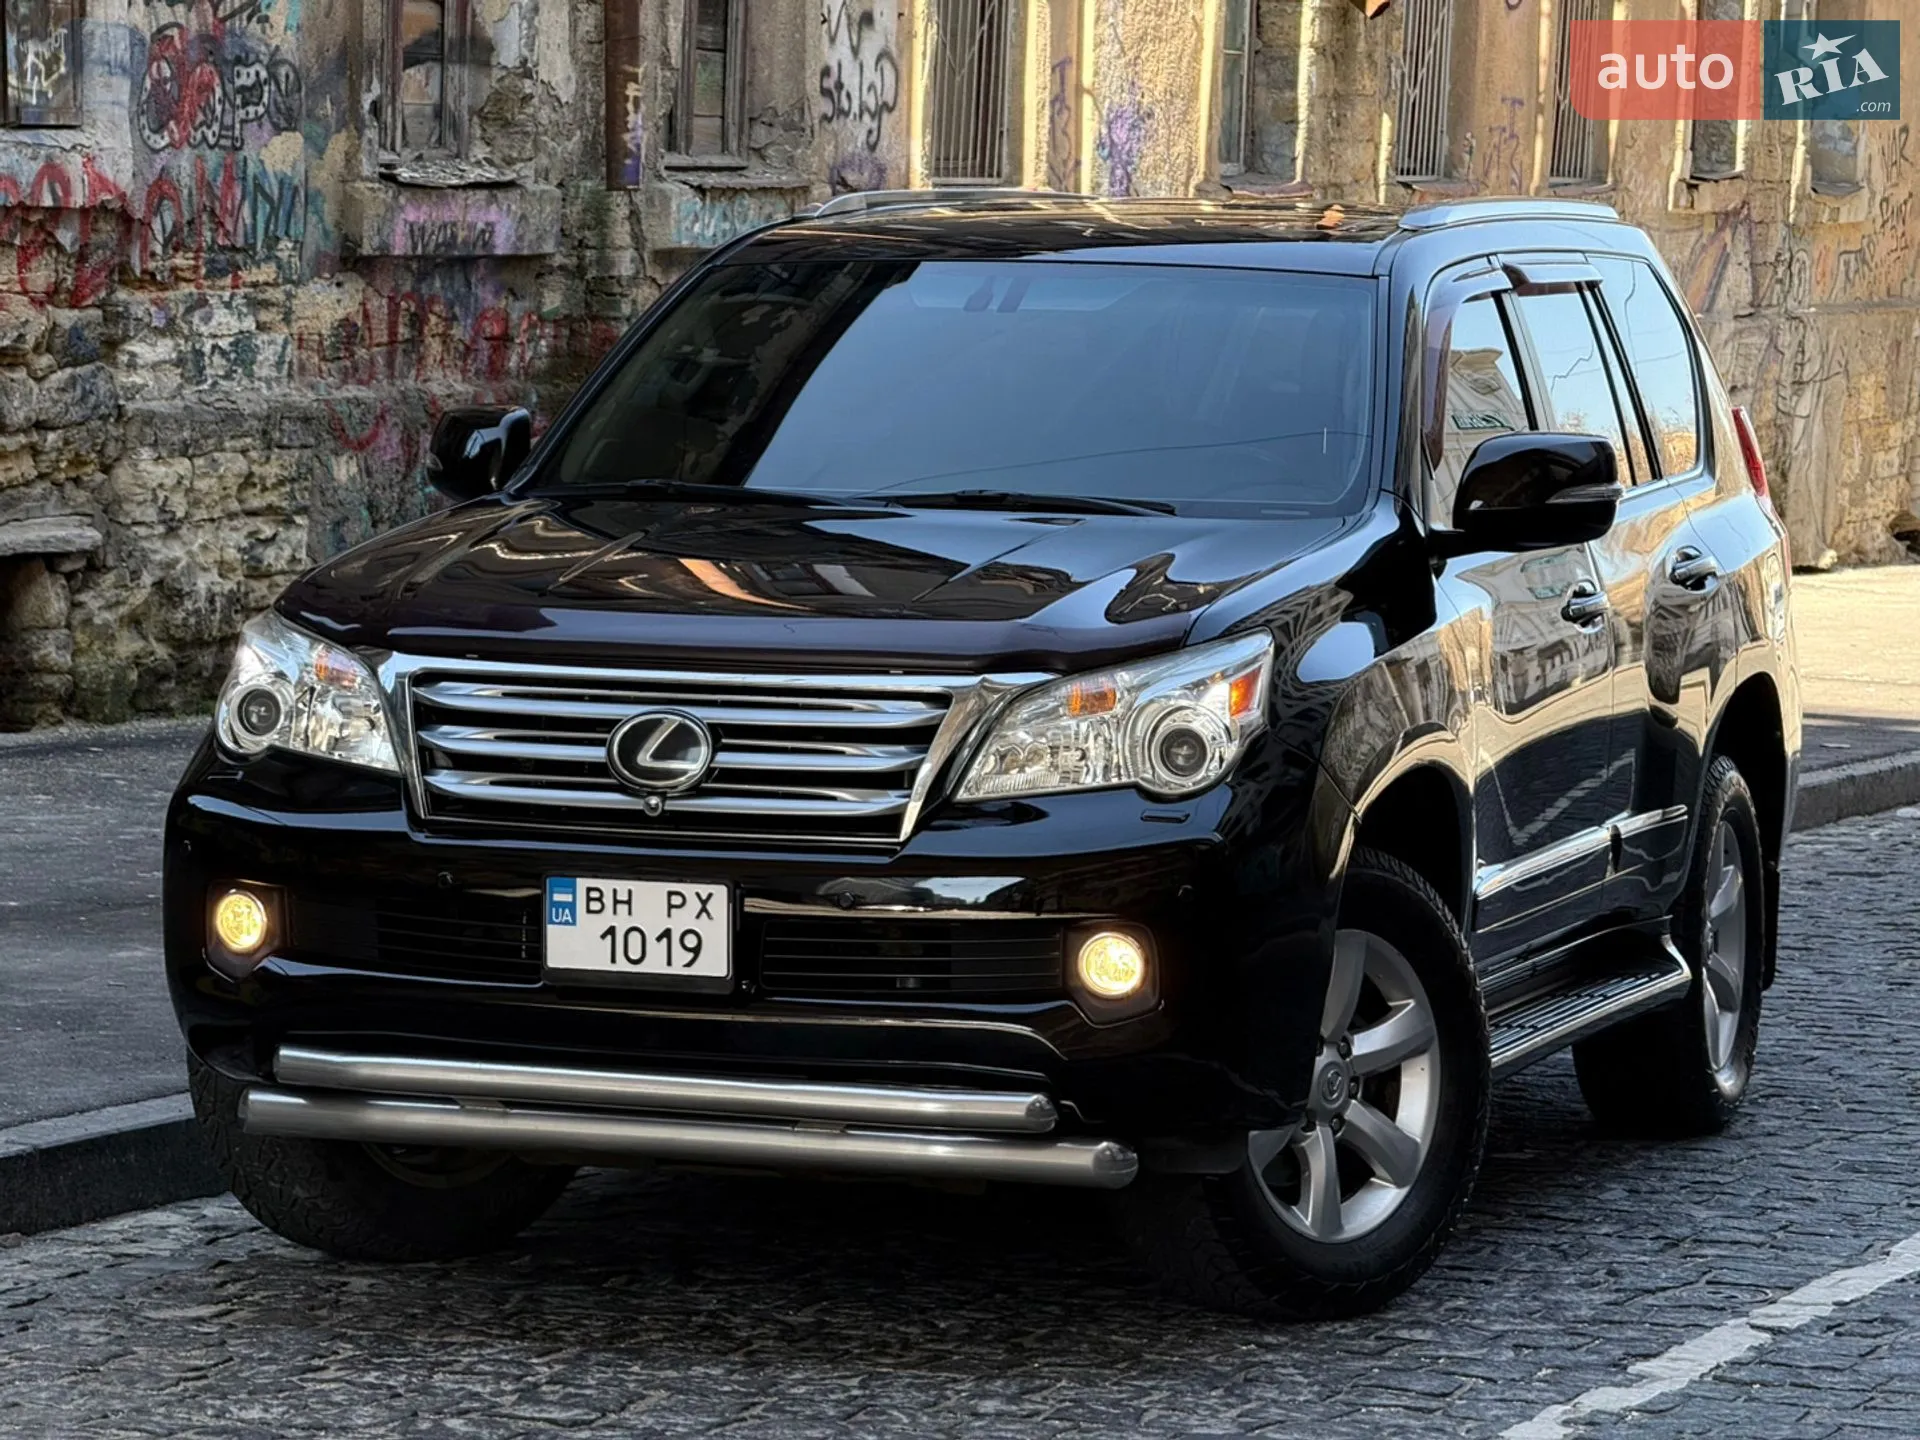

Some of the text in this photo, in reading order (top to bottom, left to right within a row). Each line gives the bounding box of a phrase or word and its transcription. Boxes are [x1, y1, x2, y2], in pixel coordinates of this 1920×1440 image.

[552, 907, 573, 924] UA
[585, 886, 714, 920] BH PX
[600, 924, 703, 968] 1019
